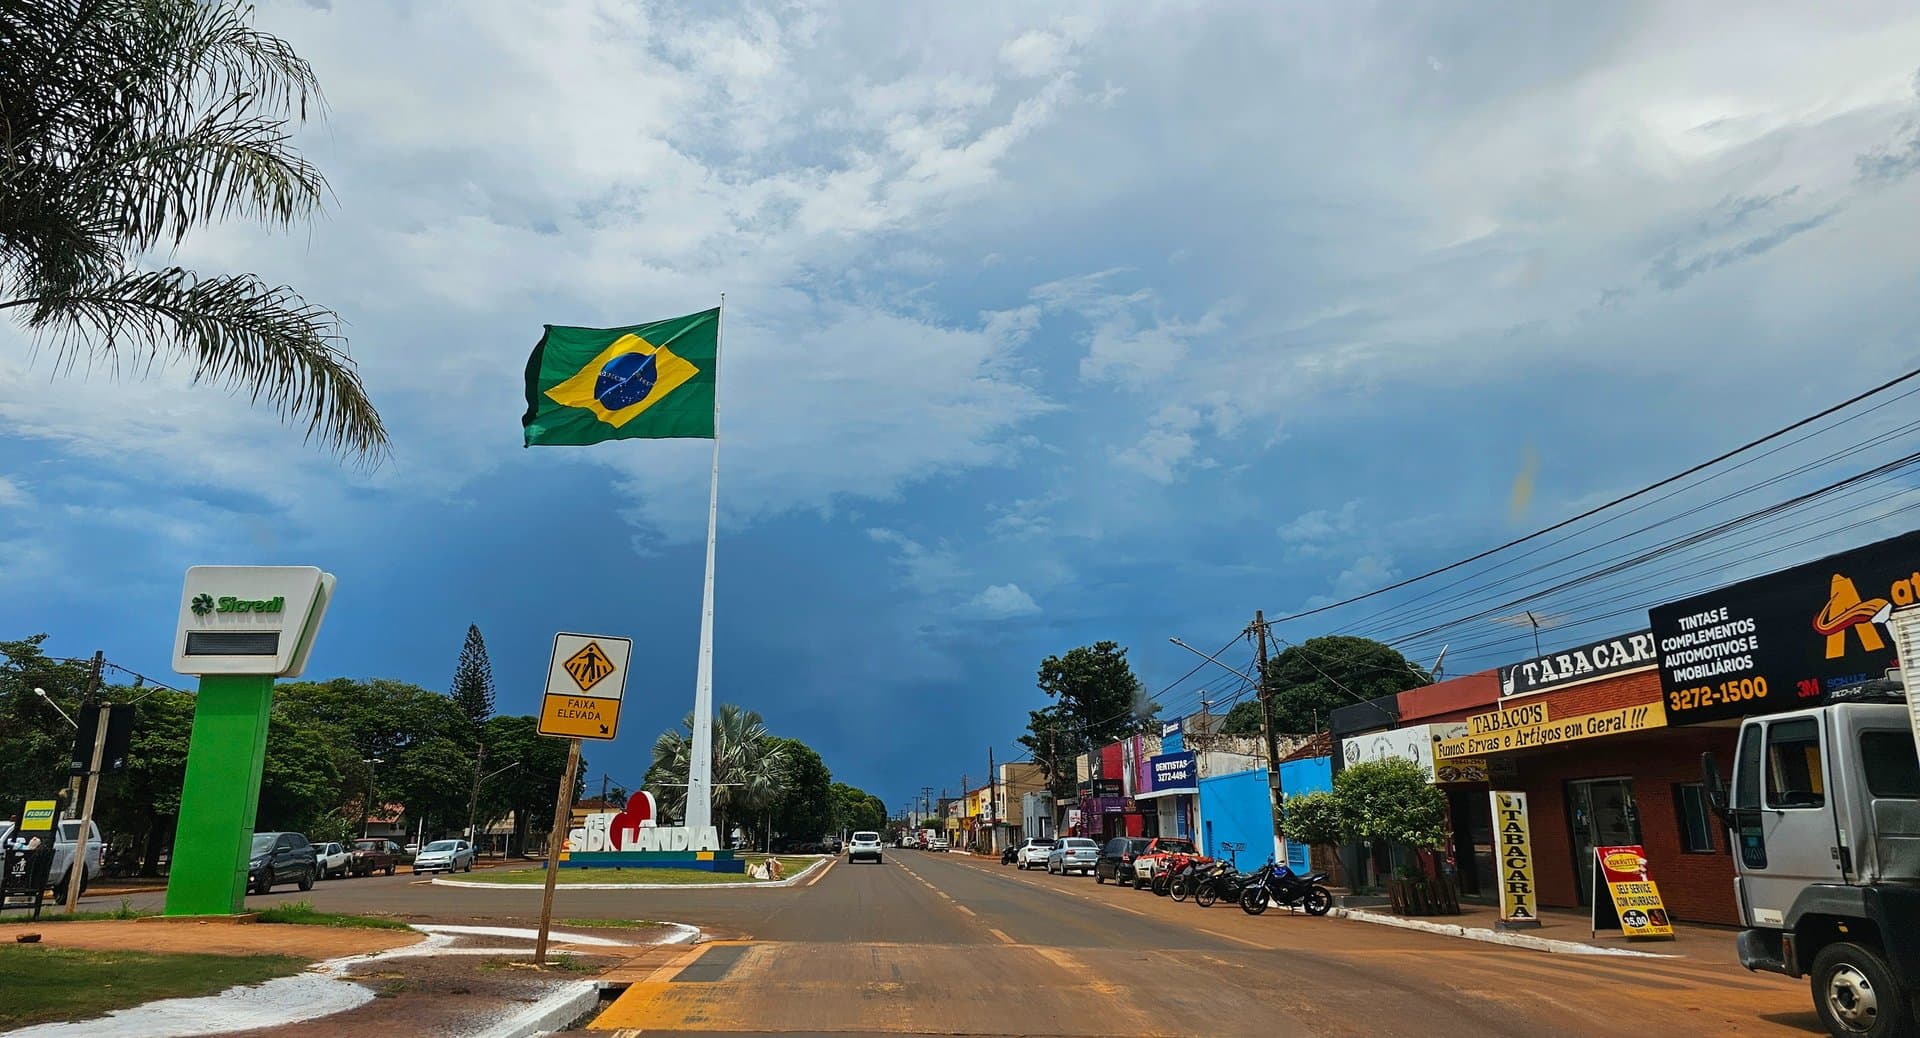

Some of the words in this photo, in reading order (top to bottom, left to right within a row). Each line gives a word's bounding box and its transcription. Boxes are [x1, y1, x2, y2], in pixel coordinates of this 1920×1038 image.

[216, 596, 284, 613] Sicredi
[1678, 609, 1719, 631] TINTAS
[1720, 607, 1728, 620] E
[1661, 618, 1756, 652] COMPLEMENTOS
[1665, 638, 1748, 668] AUTOMOTIVOS
[1748, 635, 1758, 650] E
[1673, 655, 1754, 683] IMOBILIÁRIOS
[1669, 676, 1768, 711] 3272-1500
[1796, 678, 1819, 697] 3M
[557, 709, 601, 720] ELEVADA
[568, 699, 595, 709] FAIXA
[1473, 704, 1543, 734] TABACO'S
[1438, 742, 1465, 758] Fumos
[1468, 736, 1499, 753] Ervas
[1504, 736, 1511, 748] e
[1515, 726, 1561, 746] Artigos
[1565, 724, 1583, 739] em
[1587, 711, 1627, 735] Geral
[1155, 759, 1188, 772] DENTISTAS
[1502, 809, 1534, 917] TABACARIA
[1616, 884, 1629, 894] SELF
[1629, 883, 1652, 894] SERVICE
[1616, 896, 1629, 906] COM
[1629, 895, 1660, 906] CHURRASCO
